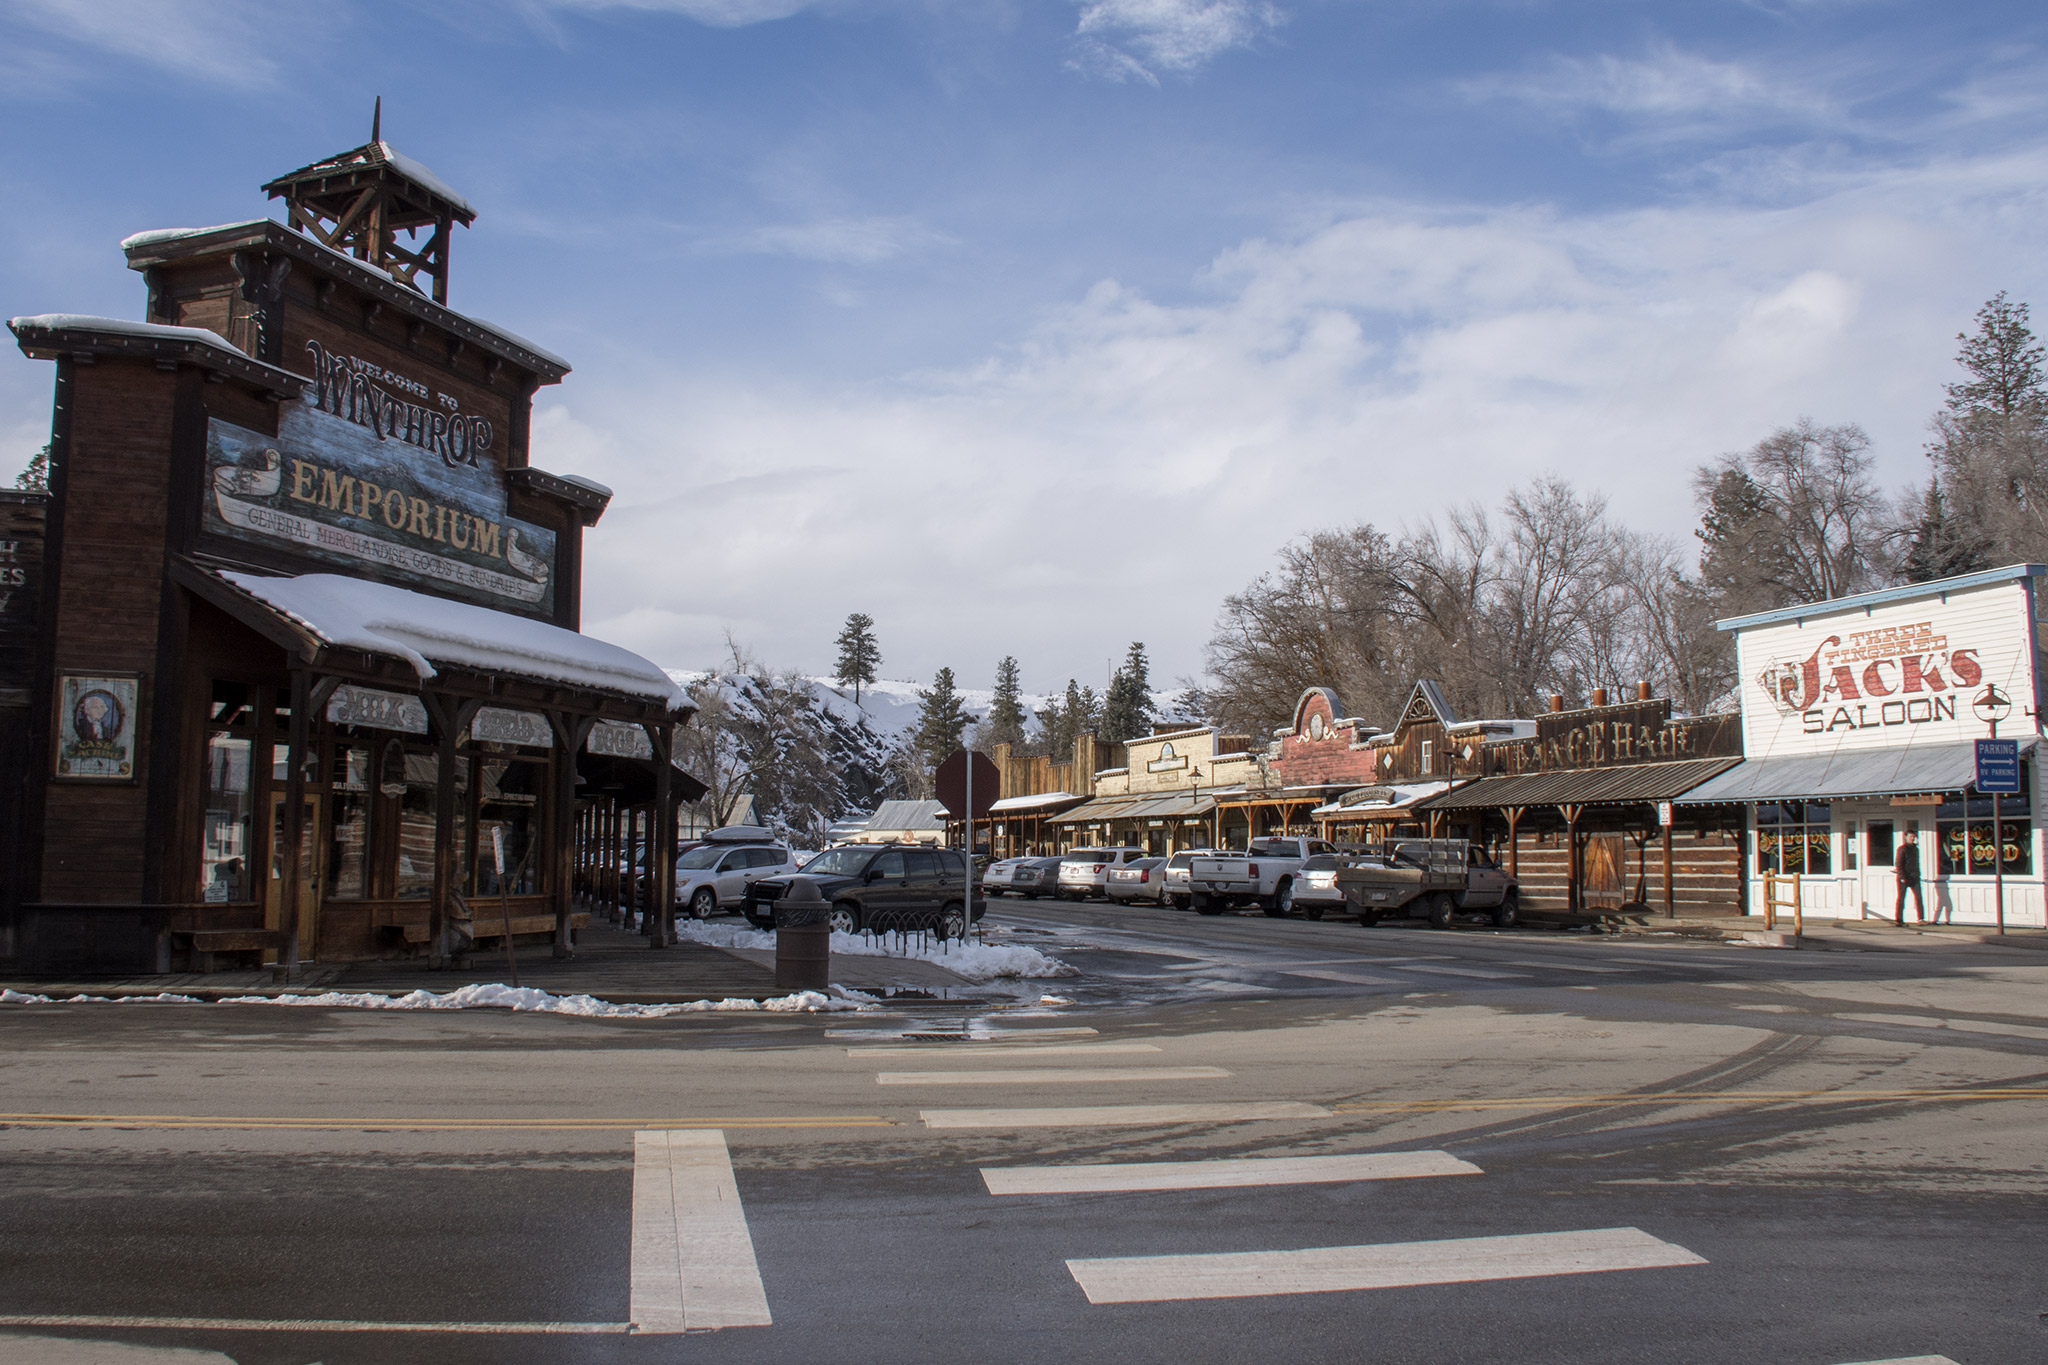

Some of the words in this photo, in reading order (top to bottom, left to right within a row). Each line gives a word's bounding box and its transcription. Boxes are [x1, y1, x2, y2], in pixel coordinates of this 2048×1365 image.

[350, 355, 429, 399] WELCOME
[437, 392, 459, 411] TO
[305, 339, 493, 471] WINTHROP
[290, 458, 501, 558] EMPORIUM
[248, 507, 311, 539] GENERAL
[412, 553, 452, 577] GOODS
[456, 566, 464, 581] &
[469, 569, 523, 595] SUNDRIES
[1849, 621, 1932, 647] THREE
[1824, 634, 1948, 666] FINGERED
[1780, 635, 1982, 711] JACK'S
[479, 710, 535, 743] BREAD
[1802, 695, 1956, 734] SALOON
[78, 740, 113, 750] CASH
[594, 727, 635, 754] EGGS
[1979, 744, 2015, 755] PARKING
[1980, 768, 1990, 776] RV
[1991, 768, 2016, 776] PARKING
[1760, 830, 1830, 852] SALOON
[1950, 824, 2018, 841] GOOD
[1950, 844, 2019, 861] FOOD
